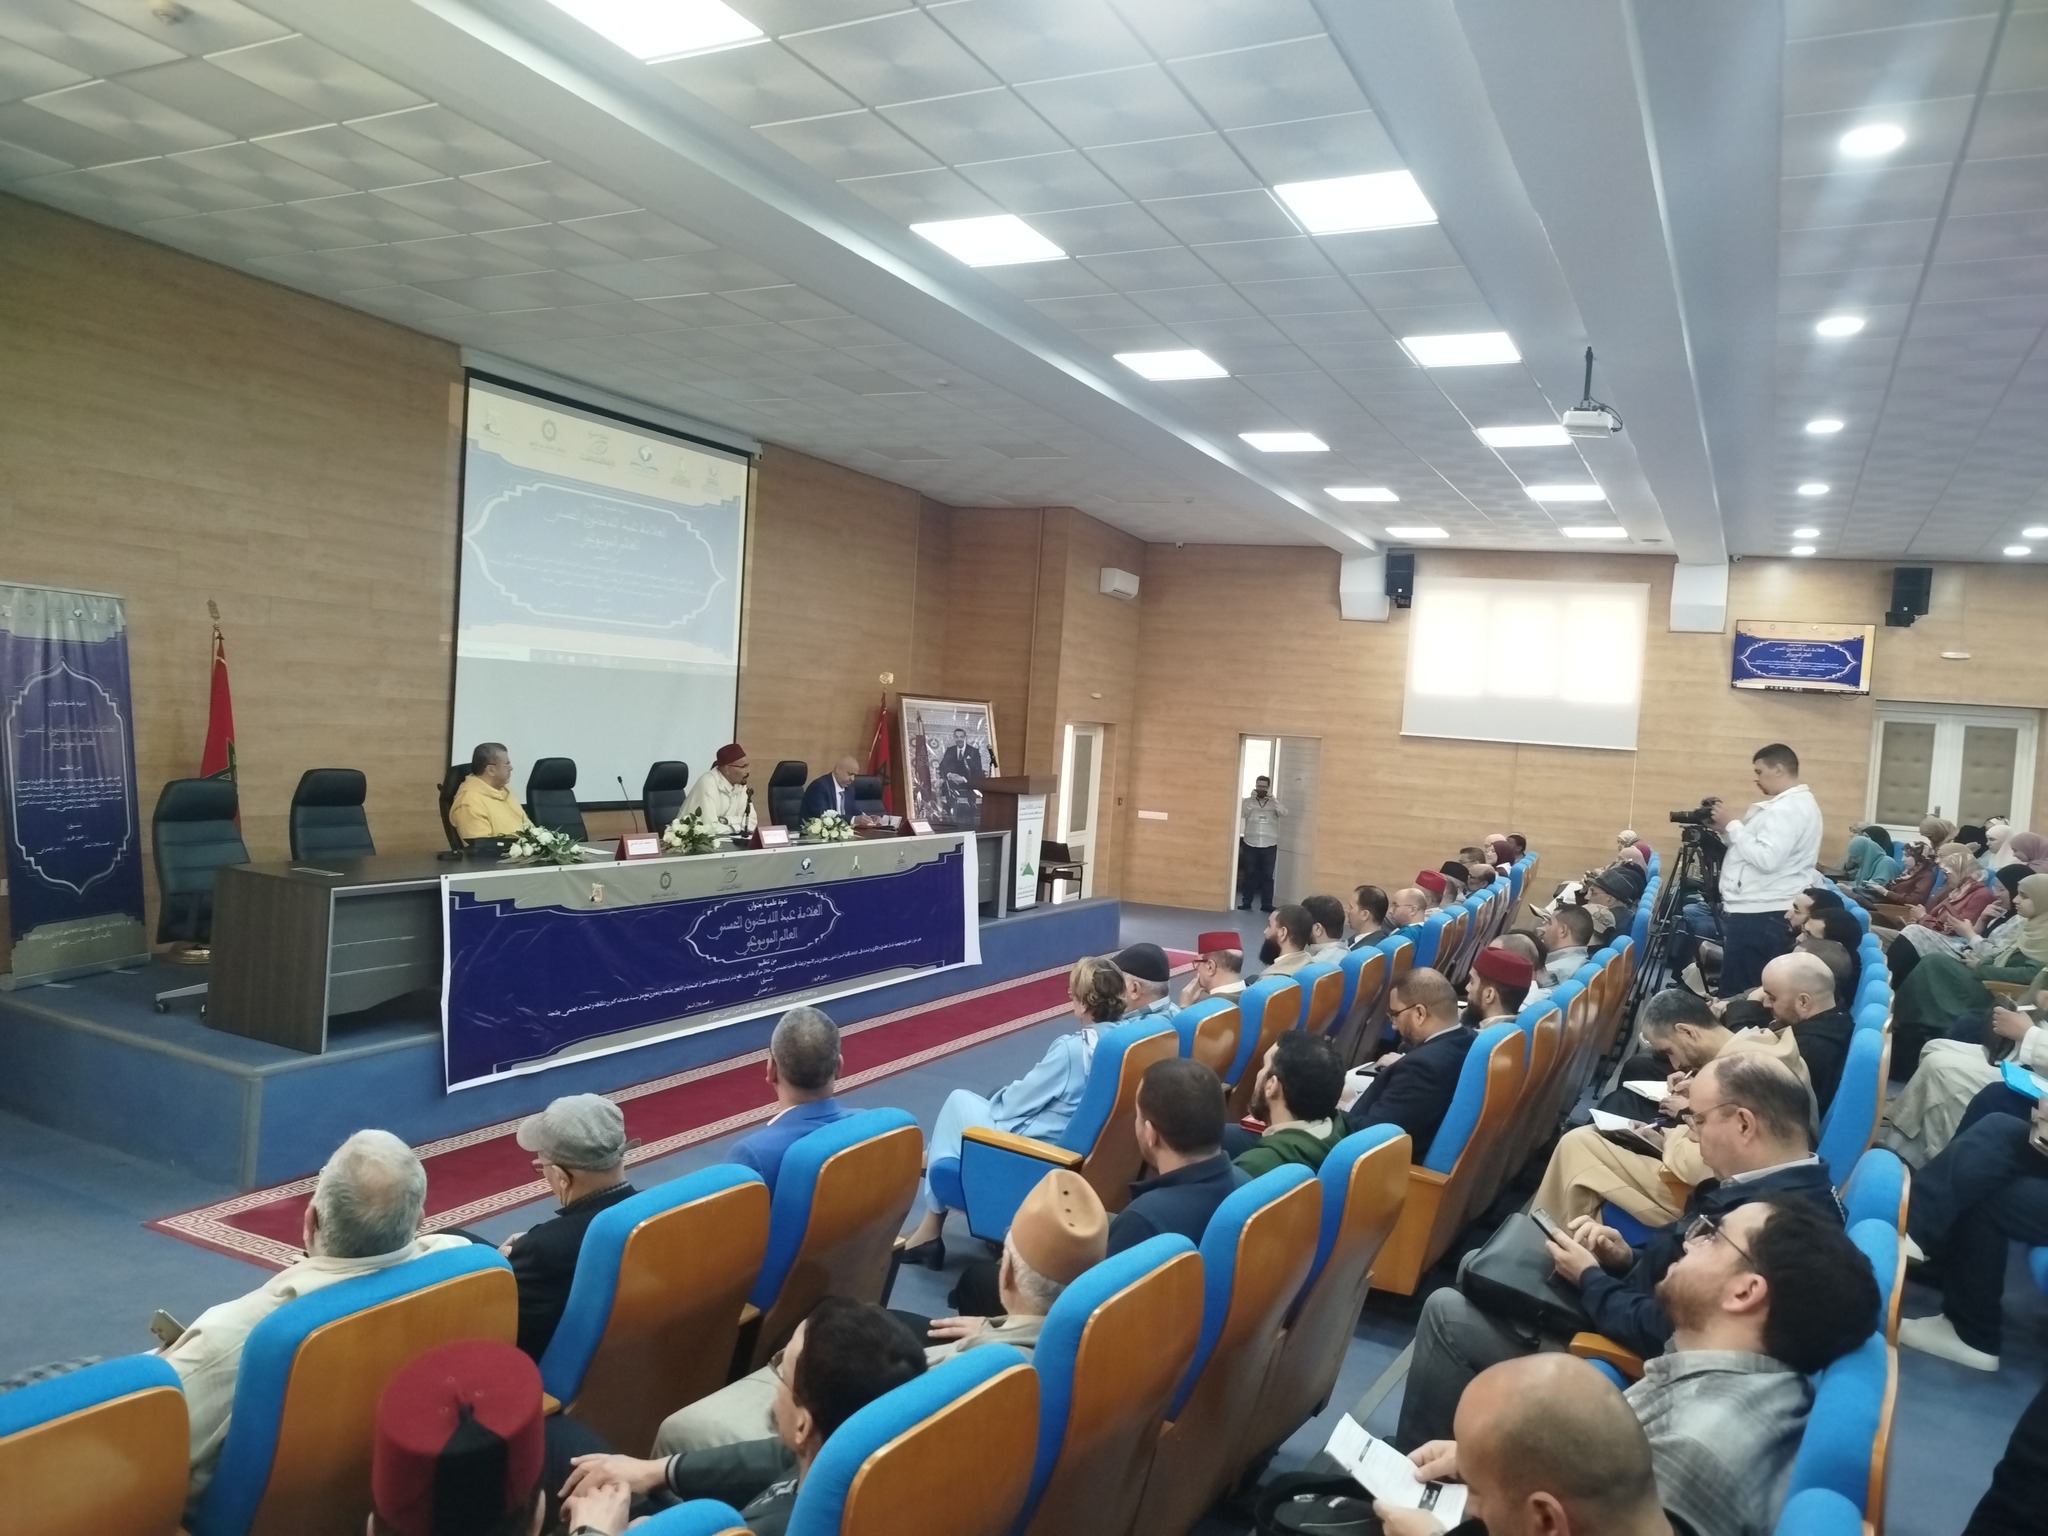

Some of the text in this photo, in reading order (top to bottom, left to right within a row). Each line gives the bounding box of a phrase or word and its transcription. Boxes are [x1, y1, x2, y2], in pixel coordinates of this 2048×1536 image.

[747, 898, 788, 912] ندوة علمية بعنوان:
[706, 904, 822, 940] العلامة عبد الله كنون الحسني
[734, 928, 798, 956] العالم الموسوعي
